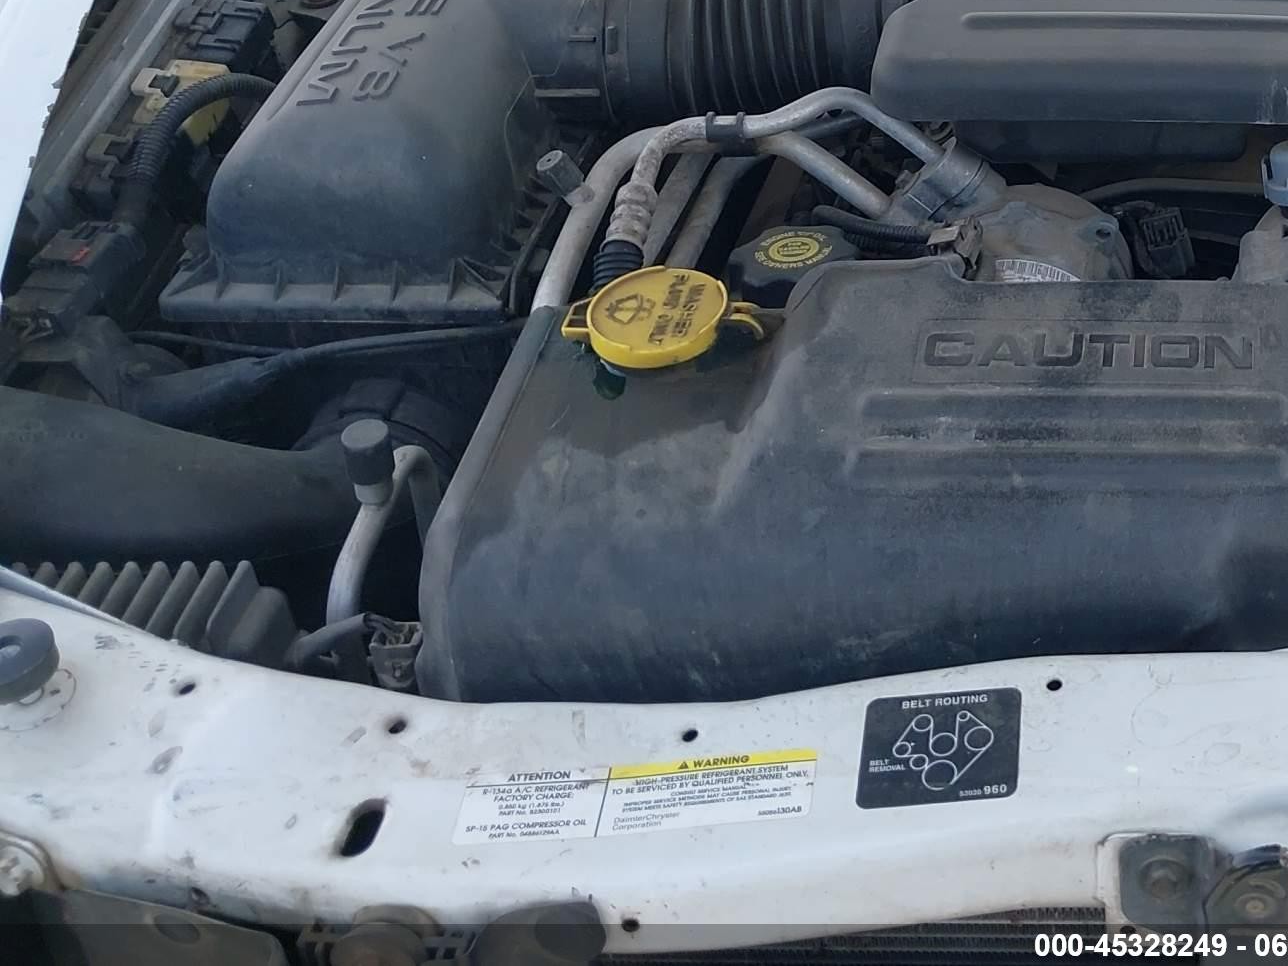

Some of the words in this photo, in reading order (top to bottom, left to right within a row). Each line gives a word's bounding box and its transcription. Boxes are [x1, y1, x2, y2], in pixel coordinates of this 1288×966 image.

[352, 32, 426, 102] V8
[923, 333, 1254, 370] CAUTION
[902, 699, 932, 709] BELT
[935, 694, 989, 707] ROUTING
[693, 755, 750, 768] WARNING
[701, 767, 756, 779] REFRIGERANT
[757, 764, 789, 773] SYSTEM
[869, 764, 906, 772] REMOVAL
[507, 771, 571, 782] ATTENTION
[514, 786, 533, 794] A/C
[534, 782, 590, 793] REFRIGERANT
[625, 786, 636, 794] BE
[637, 782, 678, 793] SERVICED
[679, 780, 691, 788] BY
[691, 776, 735, 787] QUALIFIED
[736, 772, 783, 783] PERSONNEL
[983, 784, 1008, 794] 960
[493, 794, 535, 803] FACTORY
[535, 791, 575, 801] CHARGE:
[613, 812, 681, 824] DaimlerChrysler
[489, 823, 510, 831] PAG
[511, 820, 571, 830] COMPRESSOR
[572, 818, 587, 826] OIL
[611, 821, 662, 831] Corporation
